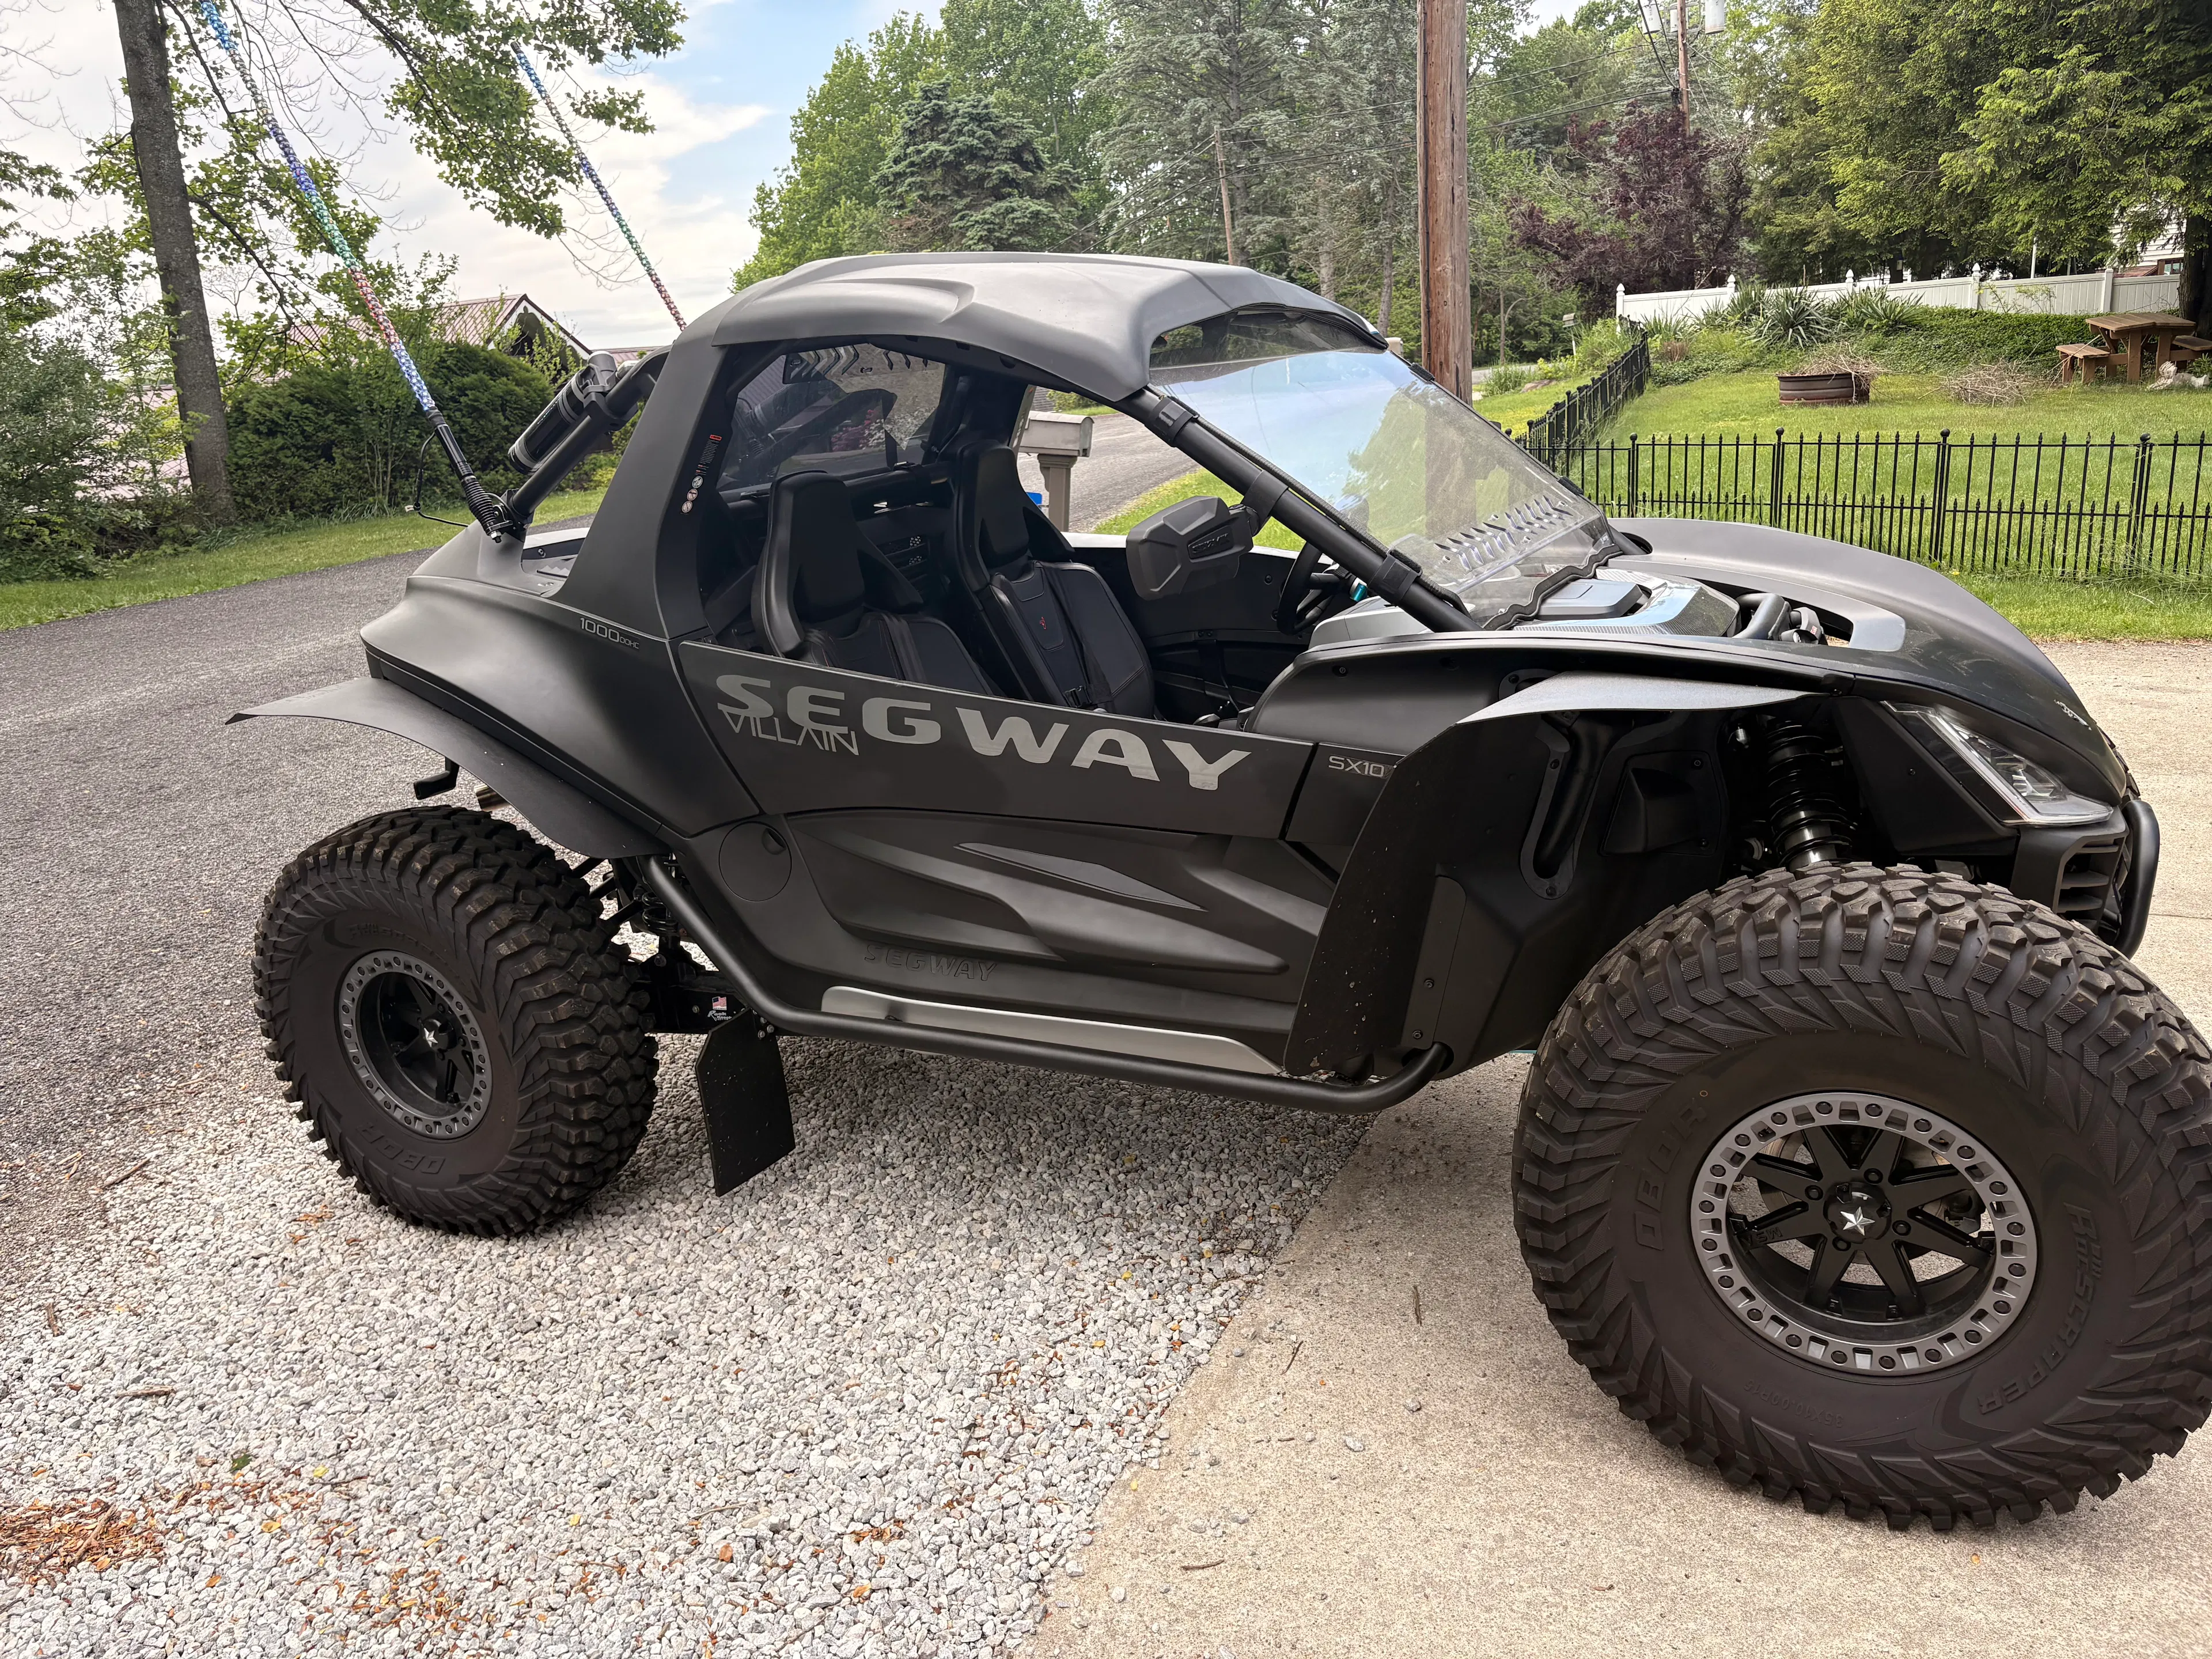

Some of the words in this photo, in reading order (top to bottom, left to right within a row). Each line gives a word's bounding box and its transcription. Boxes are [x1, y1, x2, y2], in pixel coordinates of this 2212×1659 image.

[580, 618, 619, 642] 1000
[715, 675, 1252, 791] SEGWAY
[720, 709, 859, 756] VILLAIN
[1328, 755, 1385, 778] SX10
[864, 944, 997, 981] SEGWAY
